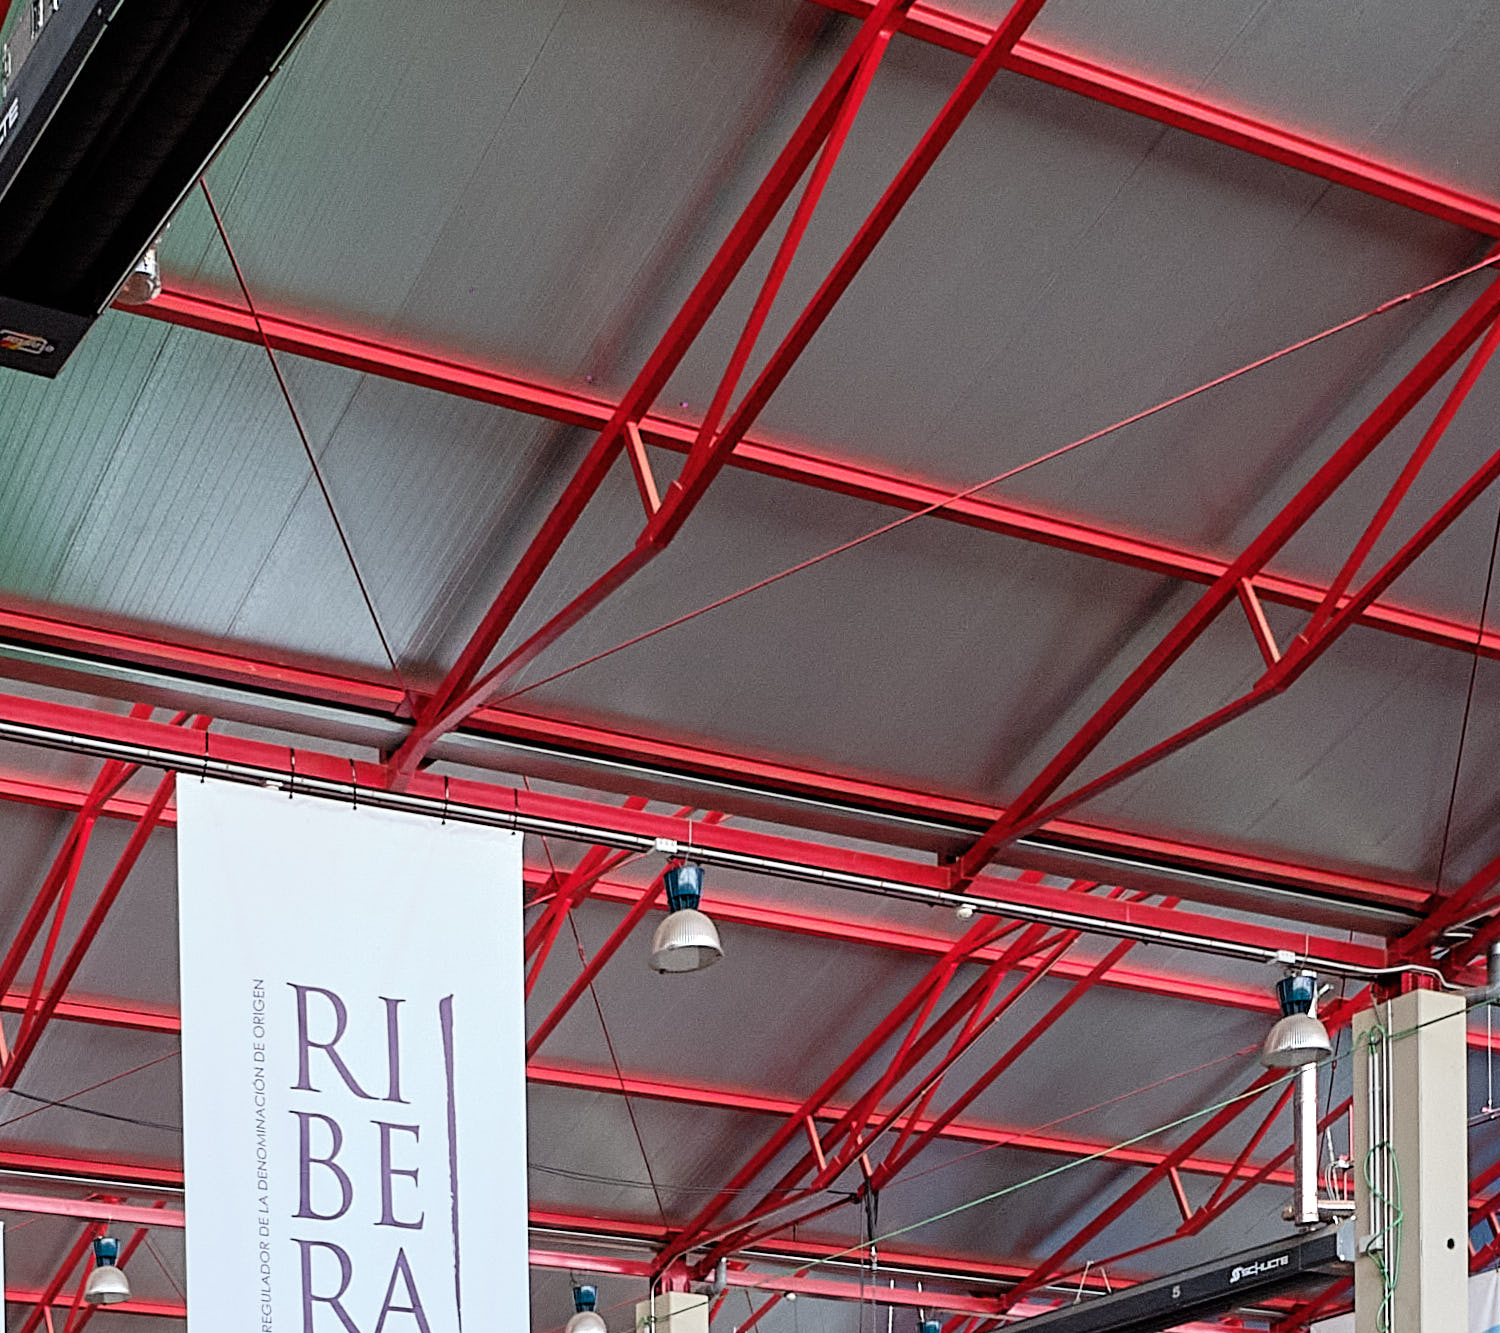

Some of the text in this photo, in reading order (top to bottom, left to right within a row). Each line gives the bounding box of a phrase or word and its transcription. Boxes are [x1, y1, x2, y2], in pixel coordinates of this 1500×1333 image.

[253, 978, 266, 1039] ORIGEN
[253, 1042, 266, 1062] DE
[253, 1067, 268, 1191] DENOMINACIÓN
[258, 1194, 269, 1214] LA
[258, 1217, 269, 1237] DE
[259, 1241, 272, 1333] REGULADOR
